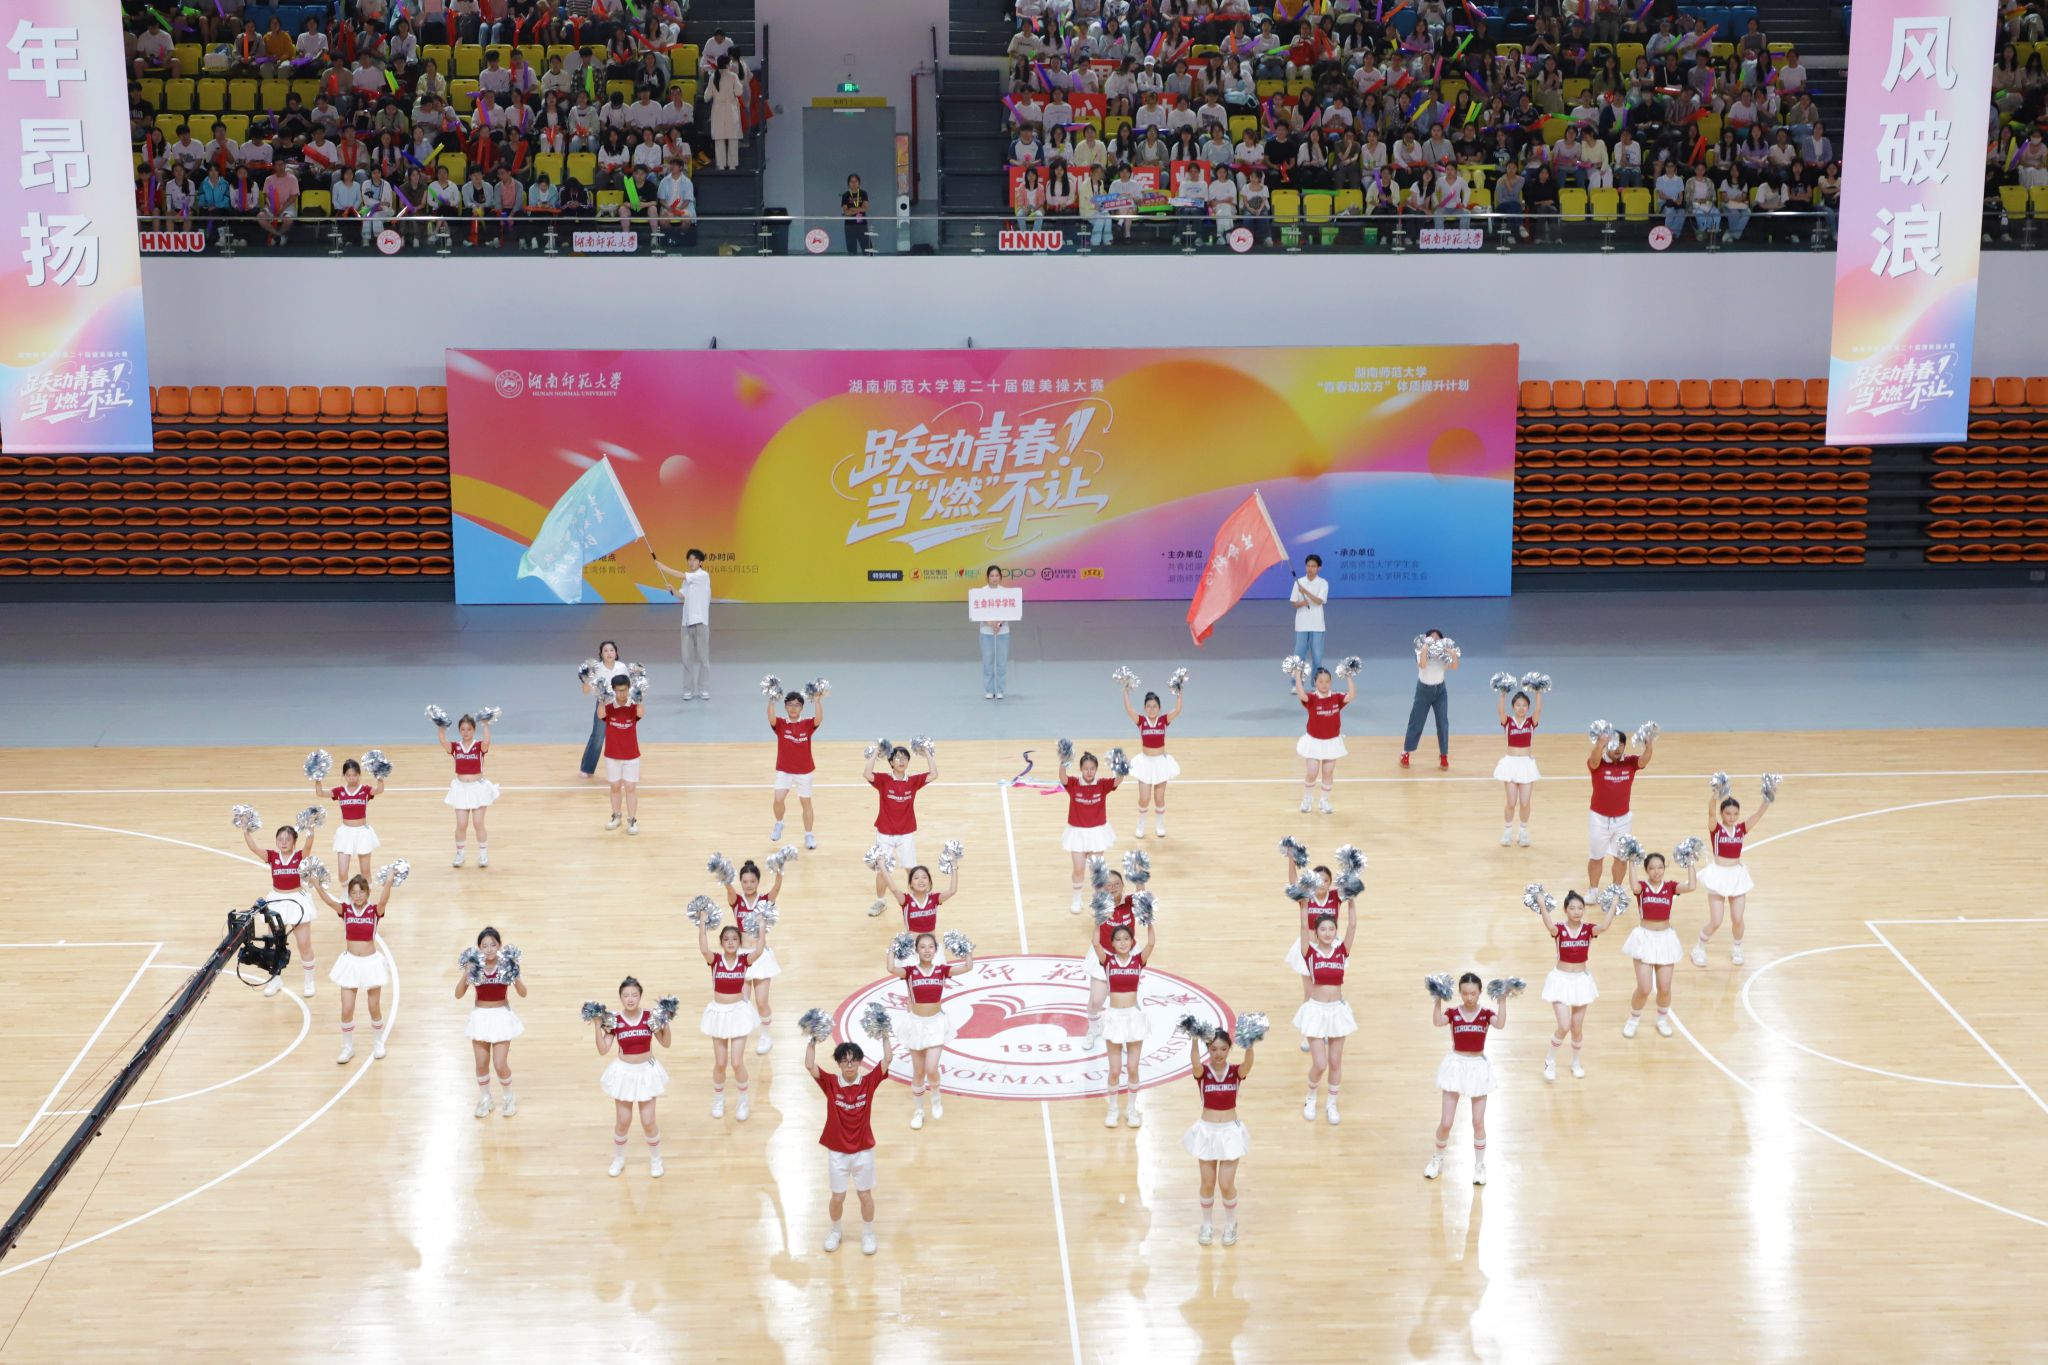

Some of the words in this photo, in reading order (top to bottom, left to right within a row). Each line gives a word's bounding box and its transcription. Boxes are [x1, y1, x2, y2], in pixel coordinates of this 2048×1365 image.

[5, 18, 100, 288] 年昂扬
[1870, 15, 1958, 279] 风破浪
[140, 233, 206, 251] HNNU
[1000, 232, 1061, 249] HNNU
[1354, 366, 1428, 379] 湖南师范大学
[848, 379, 1105, 393] 湖南师范大学第二十届健美操大赛
[1168, 550, 1203, 559] 主办单位
[1340, 548, 1375, 557] 承办单位
[973, 598, 1016, 609] 生命科学学院
[1000, 1043, 1073, 1053] 1938
